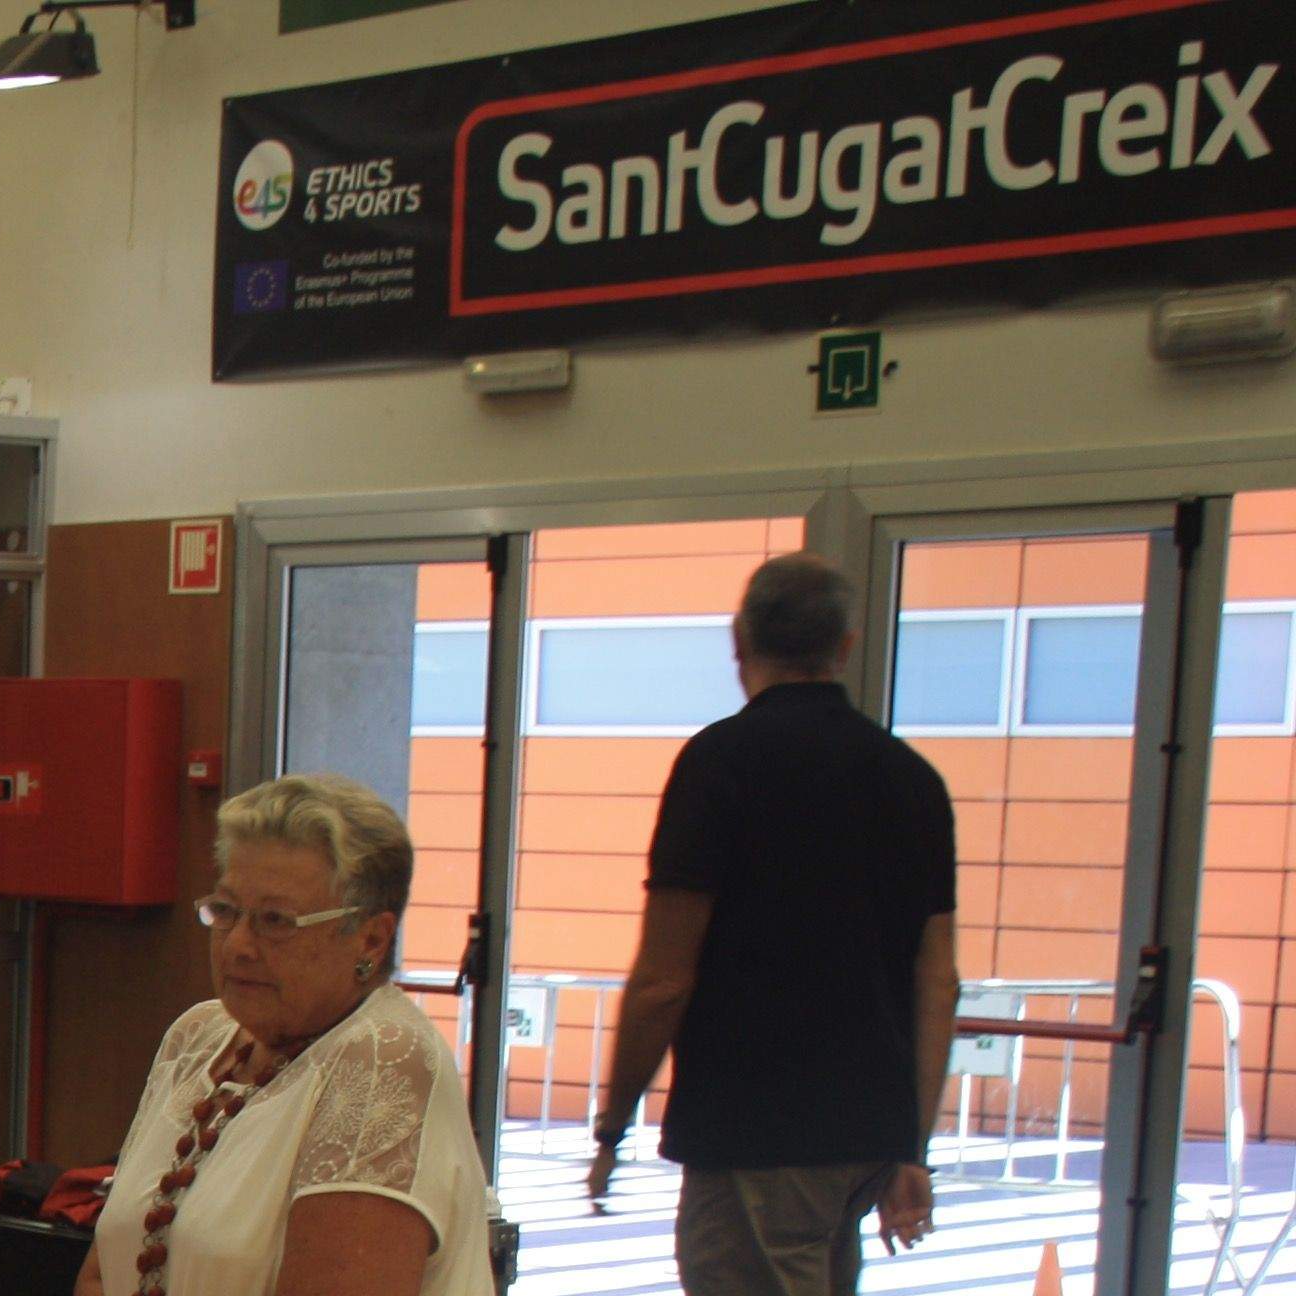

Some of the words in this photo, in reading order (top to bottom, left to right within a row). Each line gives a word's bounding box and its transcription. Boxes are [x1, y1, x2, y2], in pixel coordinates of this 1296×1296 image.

[306, 157, 395, 196] ETHICS
[303, 199, 318, 224] 4
[323, 184, 422, 222] SPORTS
[326, 287, 380, 308] European
